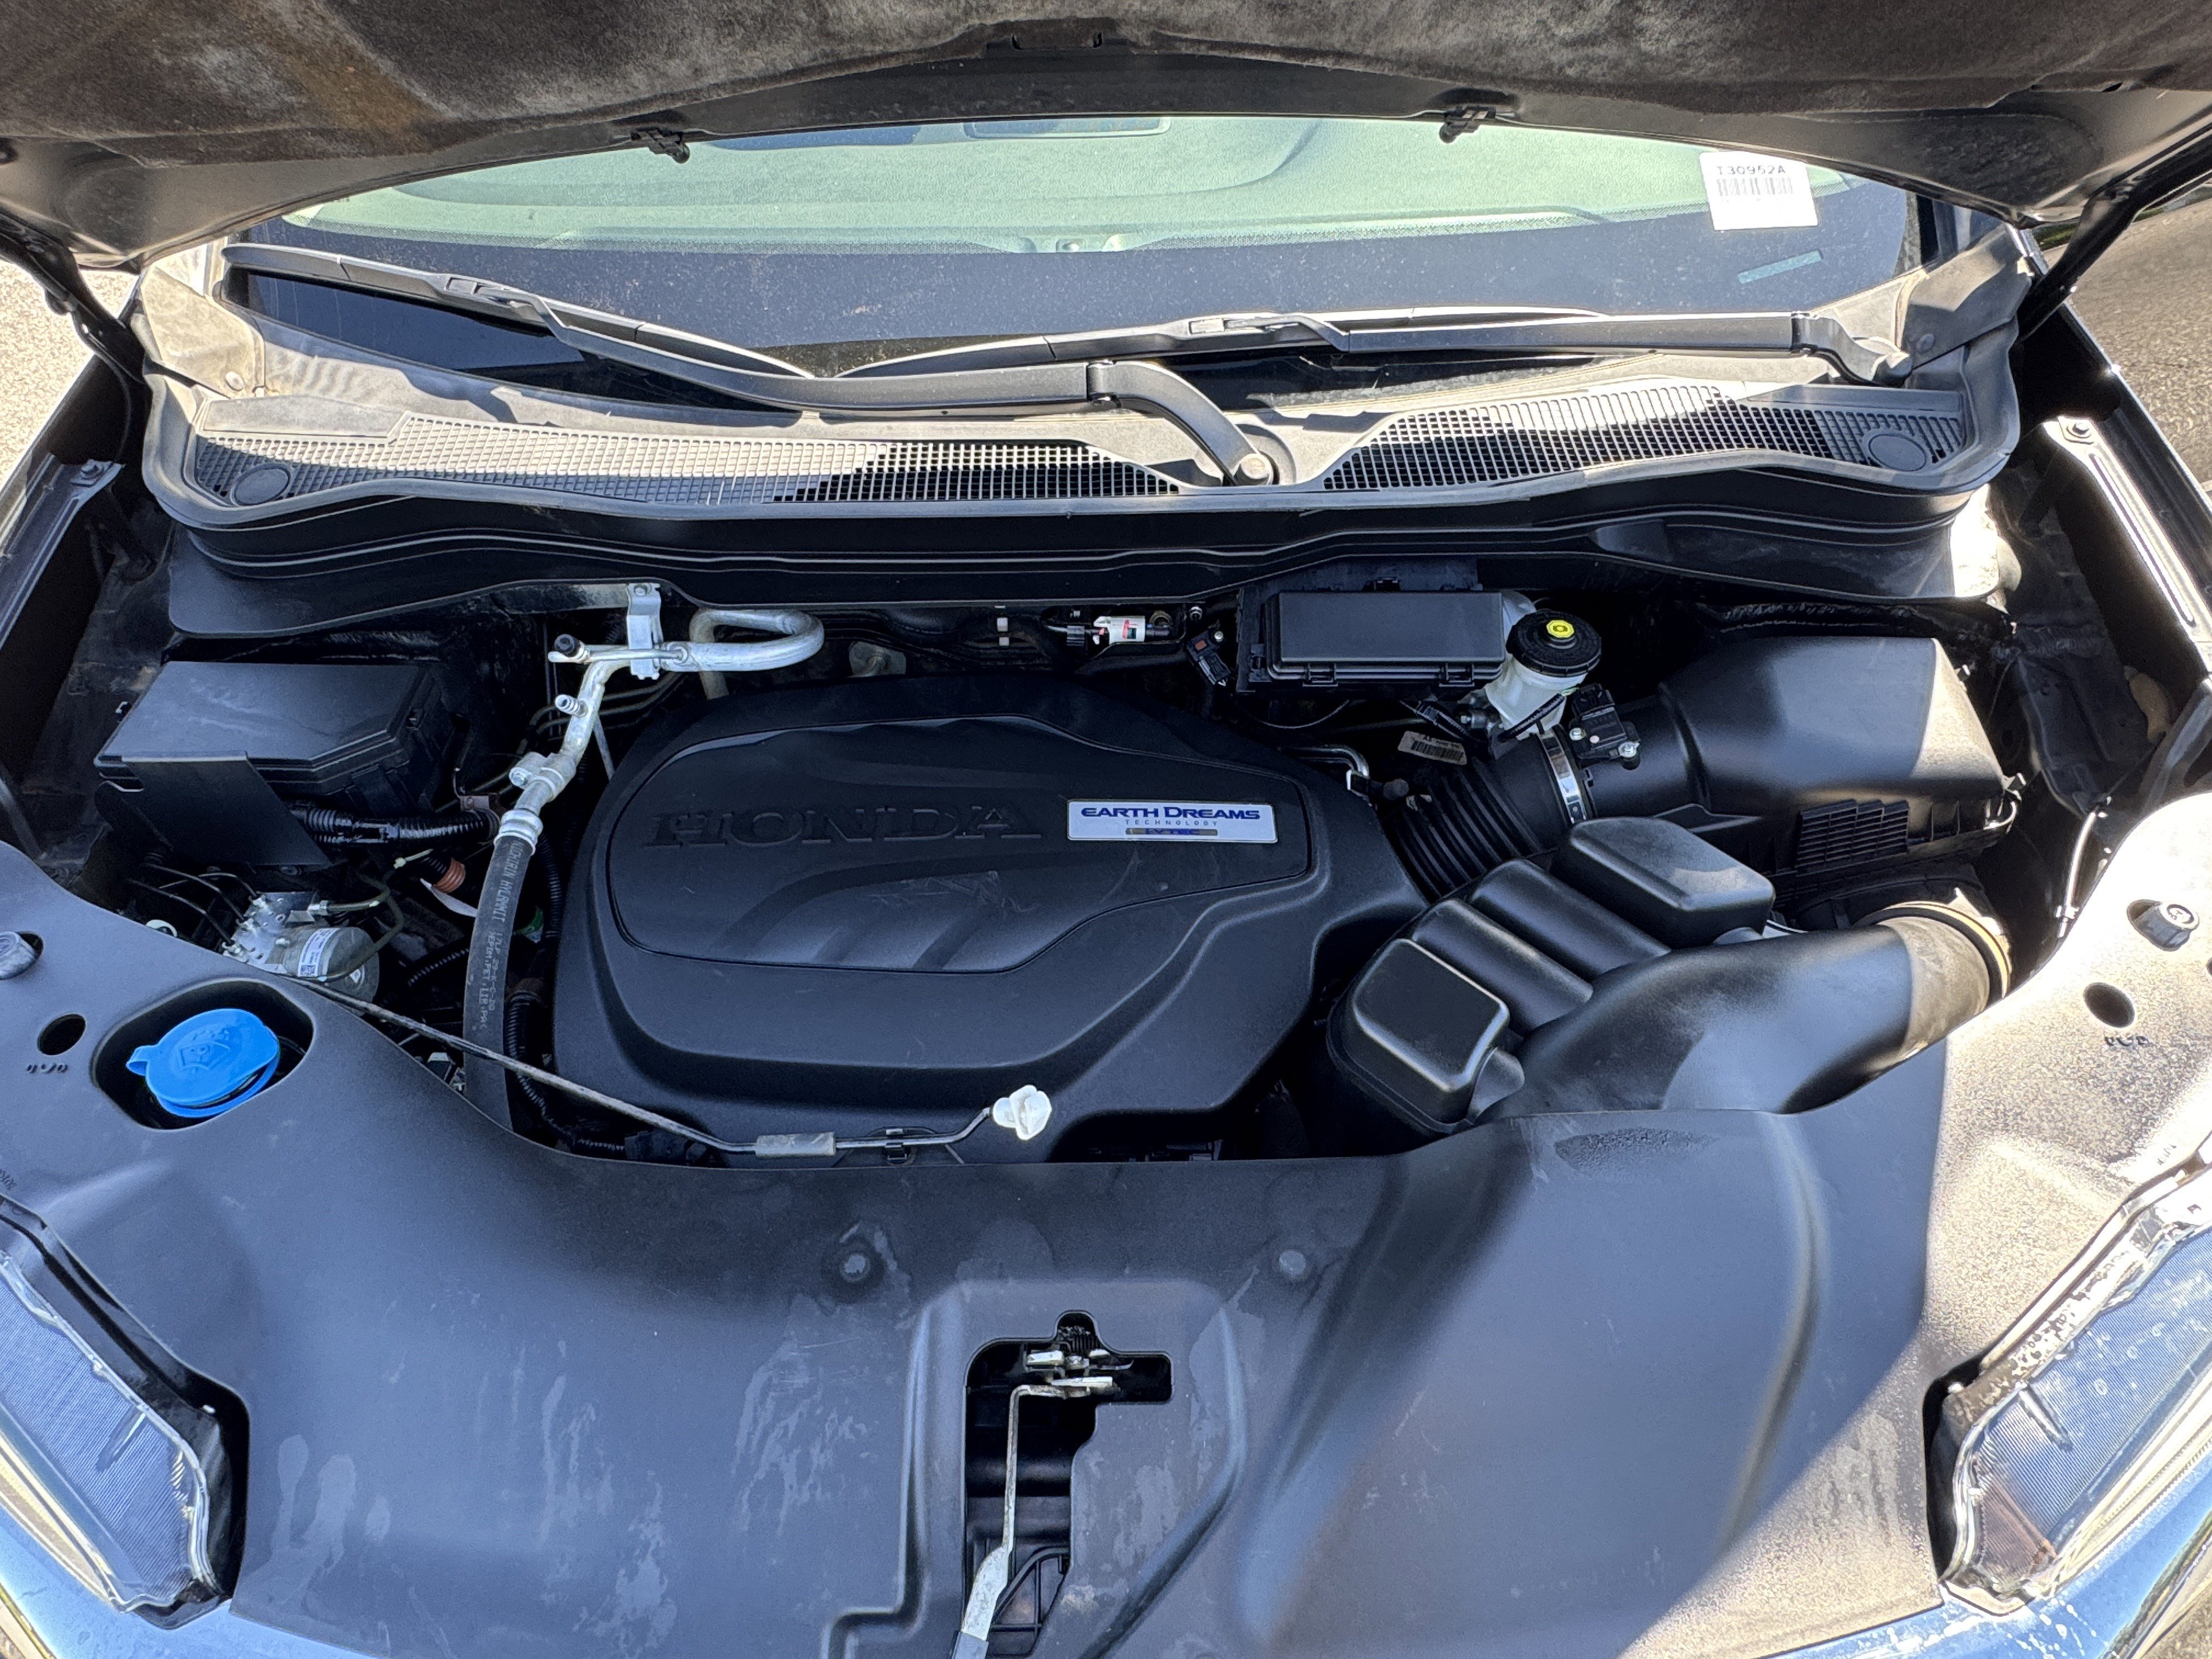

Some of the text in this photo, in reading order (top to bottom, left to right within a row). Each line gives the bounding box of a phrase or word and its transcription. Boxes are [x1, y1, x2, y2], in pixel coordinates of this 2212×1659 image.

[1717, 165, 1786, 175] T30952A
[1081, 807, 1159, 817] EARTH
[644, 805, 1042, 848] HONDA
